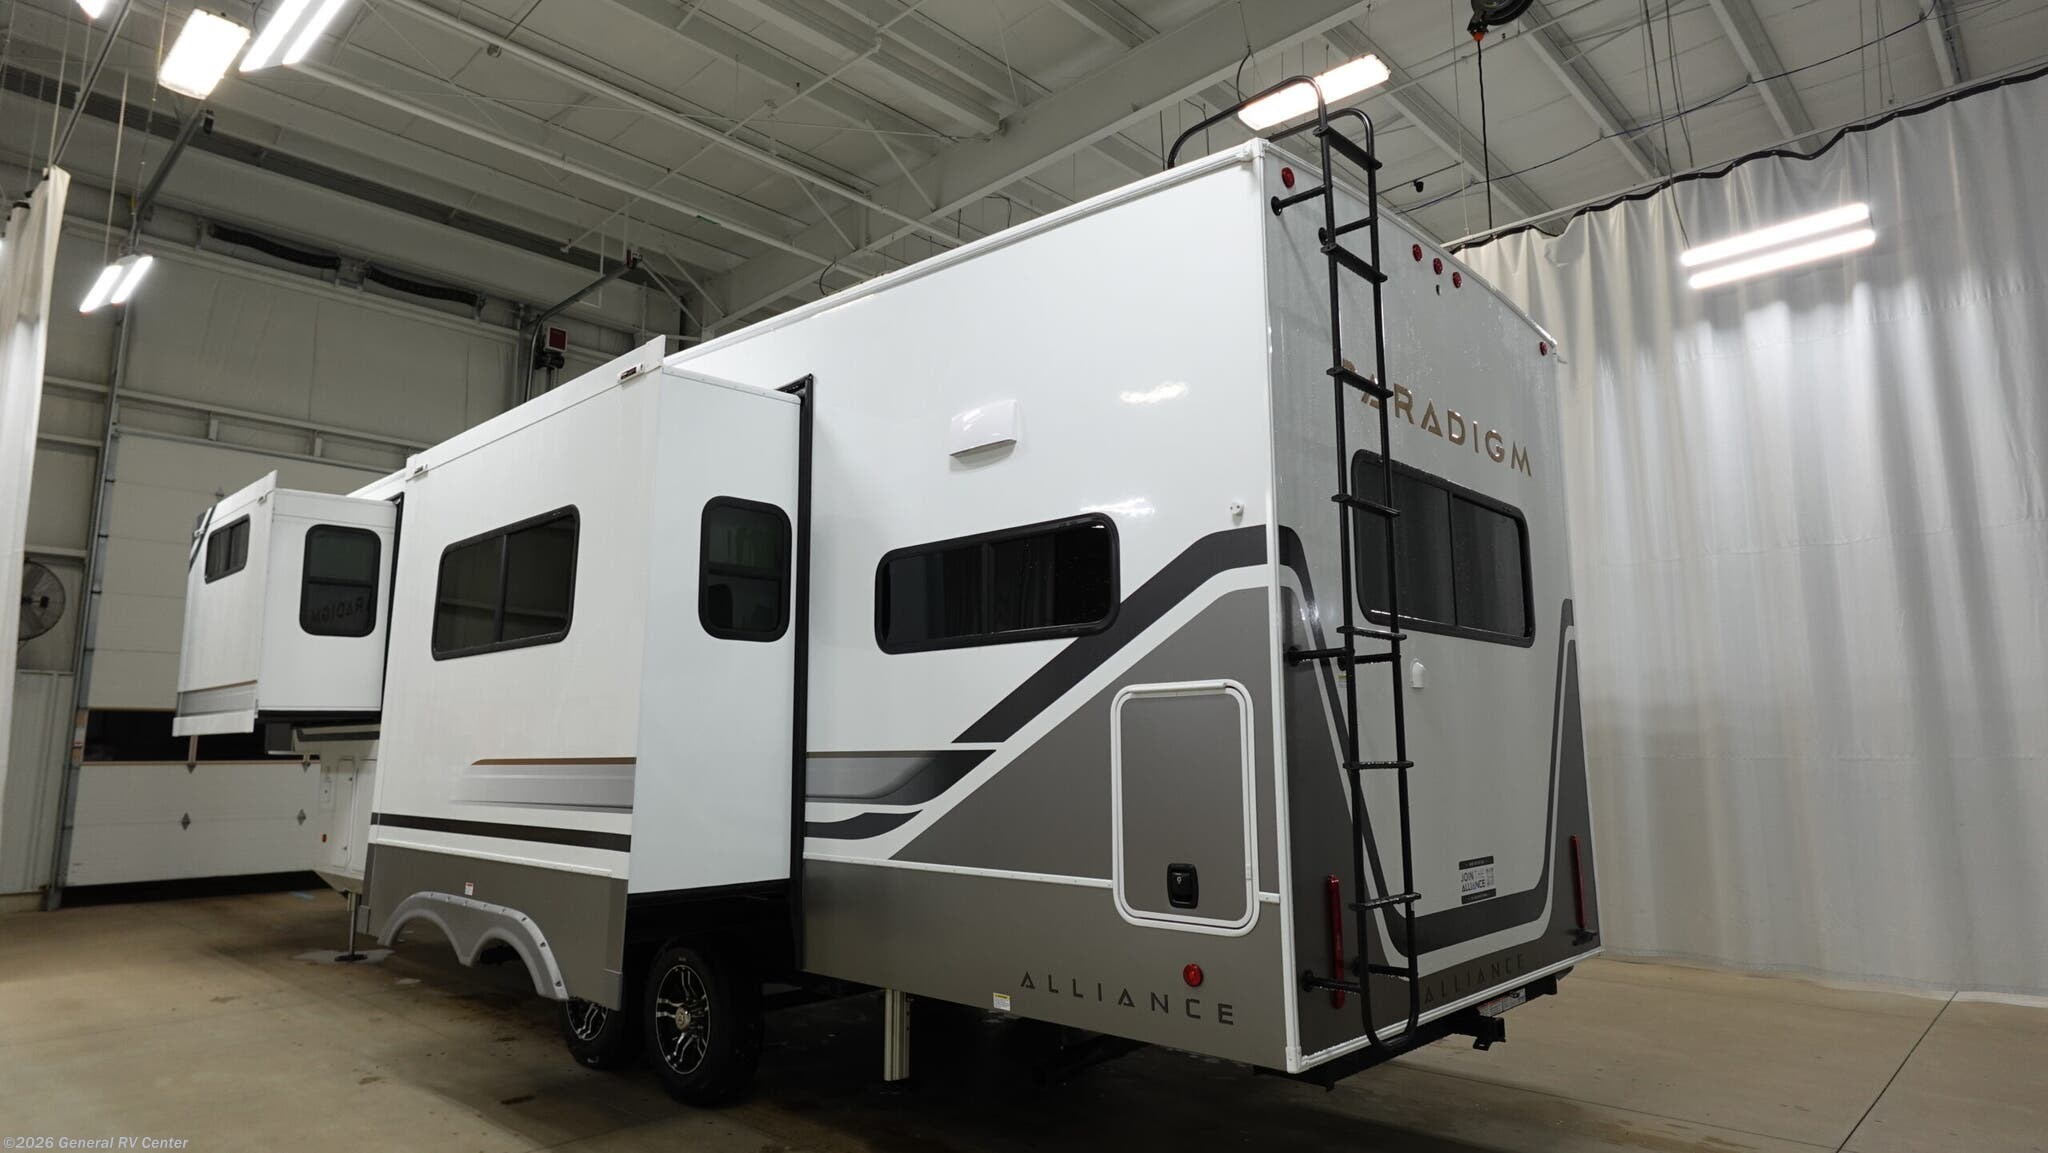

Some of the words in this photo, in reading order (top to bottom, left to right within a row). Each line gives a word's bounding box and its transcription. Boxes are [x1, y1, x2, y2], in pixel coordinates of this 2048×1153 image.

[1341, 358, 1532, 477] RADIGM
[1461, 871, 1474, 883] JOIN
[1462, 879, 1486, 892] ALLIANCE
[1020, 971, 1234, 1025] ALLIANCE
[1424, 953, 1523, 1004] ALLIANCE
